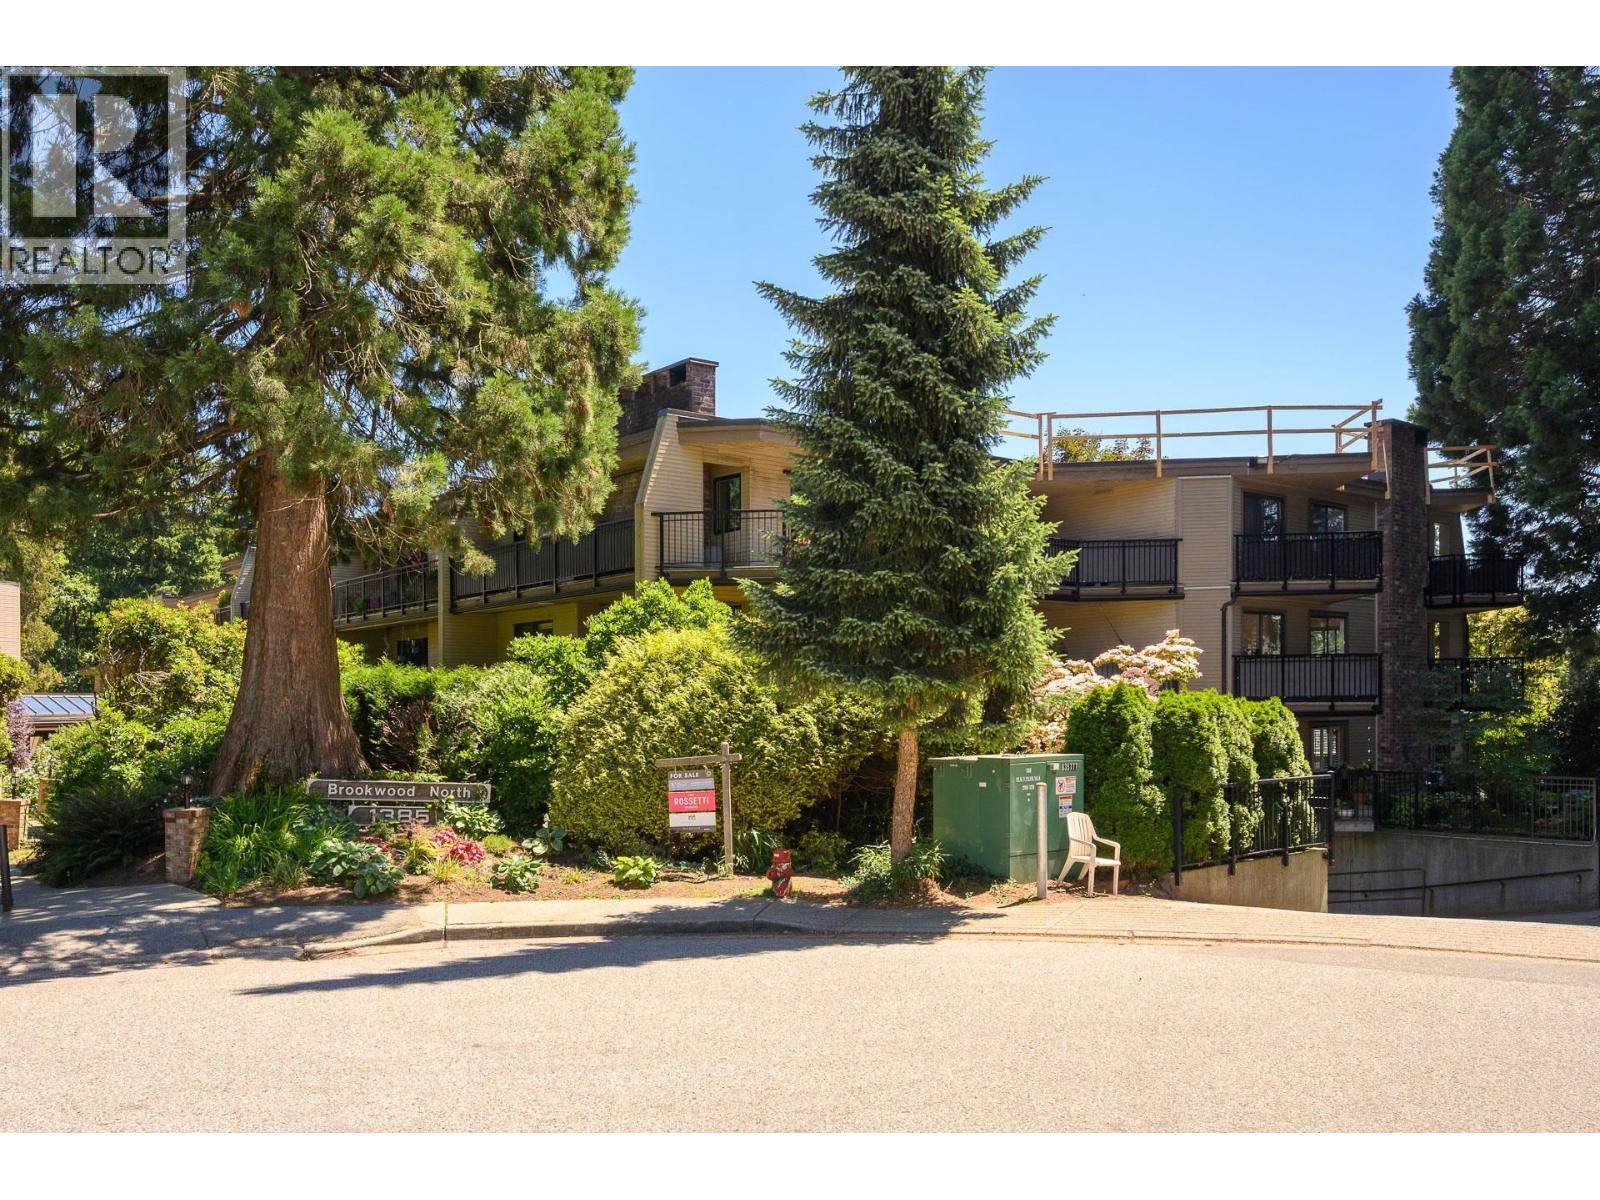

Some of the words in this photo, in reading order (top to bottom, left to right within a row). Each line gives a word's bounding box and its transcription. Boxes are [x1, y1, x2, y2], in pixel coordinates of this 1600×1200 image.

[328, 783, 415, 797] Brookwood
[430, 786, 471, 798] North
[673, 796, 709, 806] ROSSETTI
[369, 808, 430, 824] 1385
